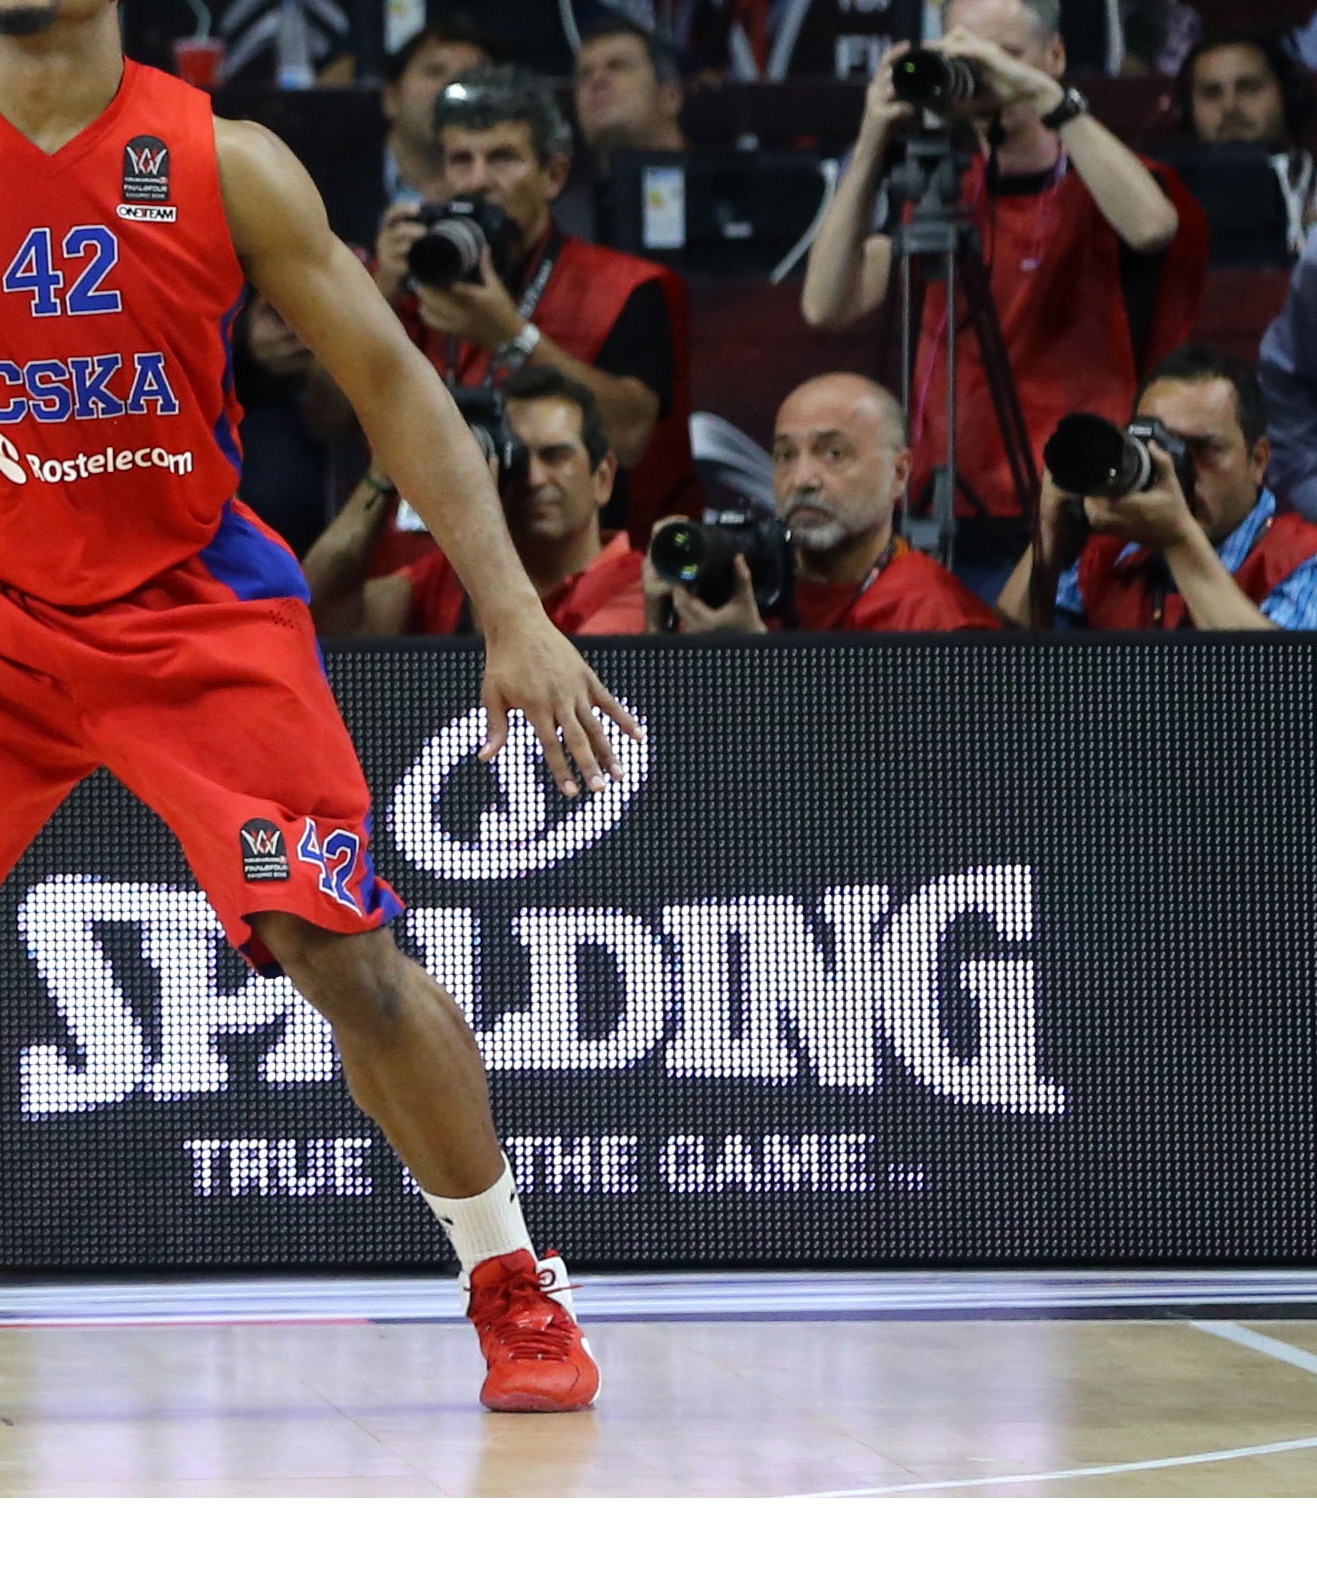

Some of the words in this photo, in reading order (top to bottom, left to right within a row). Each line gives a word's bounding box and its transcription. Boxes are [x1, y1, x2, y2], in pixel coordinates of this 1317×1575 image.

[2, 224, 122, 317] 42
[25, 446, 193, 484] Rostelecom
[297, 816, 363, 918] 42
[180, 1136, 373, 1197] TRUE
